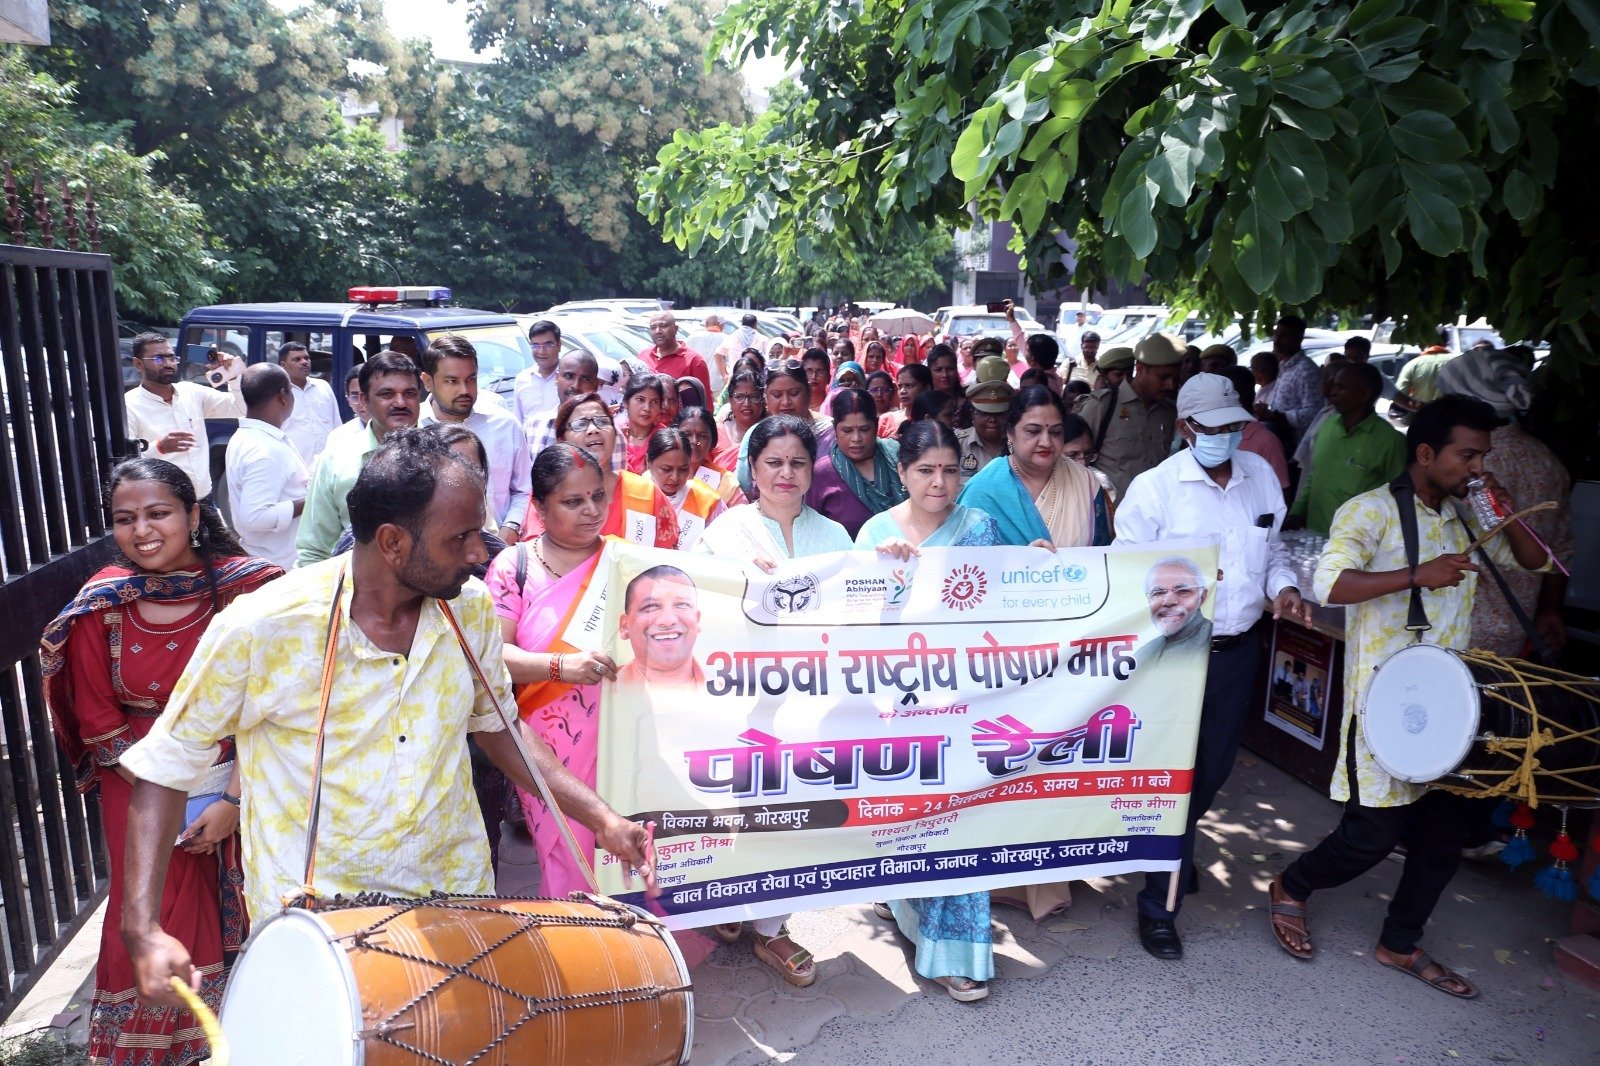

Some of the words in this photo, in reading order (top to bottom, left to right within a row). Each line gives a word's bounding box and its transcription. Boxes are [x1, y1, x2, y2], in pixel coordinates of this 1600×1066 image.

[635, 519, 645, 541] 2025
[1001, 565, 1060, 584] unicef
[1002, 596, 1019, 608] for
[1022, 596, 1058, 609] every
[1060, 593, 1091, 606] child
[706, 632, 829, 697] आठवां
[838, 632, 957, 706] राष्ट्रीय
[965, 630, 1060, 689] पोषण
[1067, 634, 1139, 681] माह
[878, 707, 899, 719] के
[900, 703, 969, 718] अन्तर्गत
[683, 727, 951, 798] पोषण
[972, 704, 1142, 780] रैली
[857, 798, 905, 819] दिनांक
[923, 801, 943, 814] 24
[999, 781, 1038, 796] 2025,
[1043, 777, 1080, 793] समय
[1096, 775, 1125, 790] प्रातः
[1130, 775, 1143, 788] 11
[1148, 771, 1173, 788] बजे
[1110, 796, 1143, 811] दीपक
[1146, 796, 1177, 810] मीणा
[662, 811, 708, 830] विकास
[711, 813, 750, 830] भवन,
[753, 806, 811, 829] गोरखपुर
[915, 812, 959, 830] त्रिपुरारी
[657, 840, 697, 860] कुमार
[700, 835, 735, 850] मिश्रा
[896, 842, 928, 852] गोरखपुर
[656, 861, 678, 872] र्यक्रम
[679, 855, 714, 868] अधिकारी
[672, 888, 702, 904] बाल
[706, 879, 758, 900] विकास
[760, 873, 791, 891] सेवा
[793, 866, 817, 888] एवं
[819, 863, 877, 889] पुष्टाहार
[880, 858, 931, 876] विभाग,
[934, 853, 979, 871] जनपद
[991, 846, 1056, 867] गोरखपुर,
[1058, 842, 1096, 858] उत्तर
[1097, 838, 1130, 856] प्रदेश
